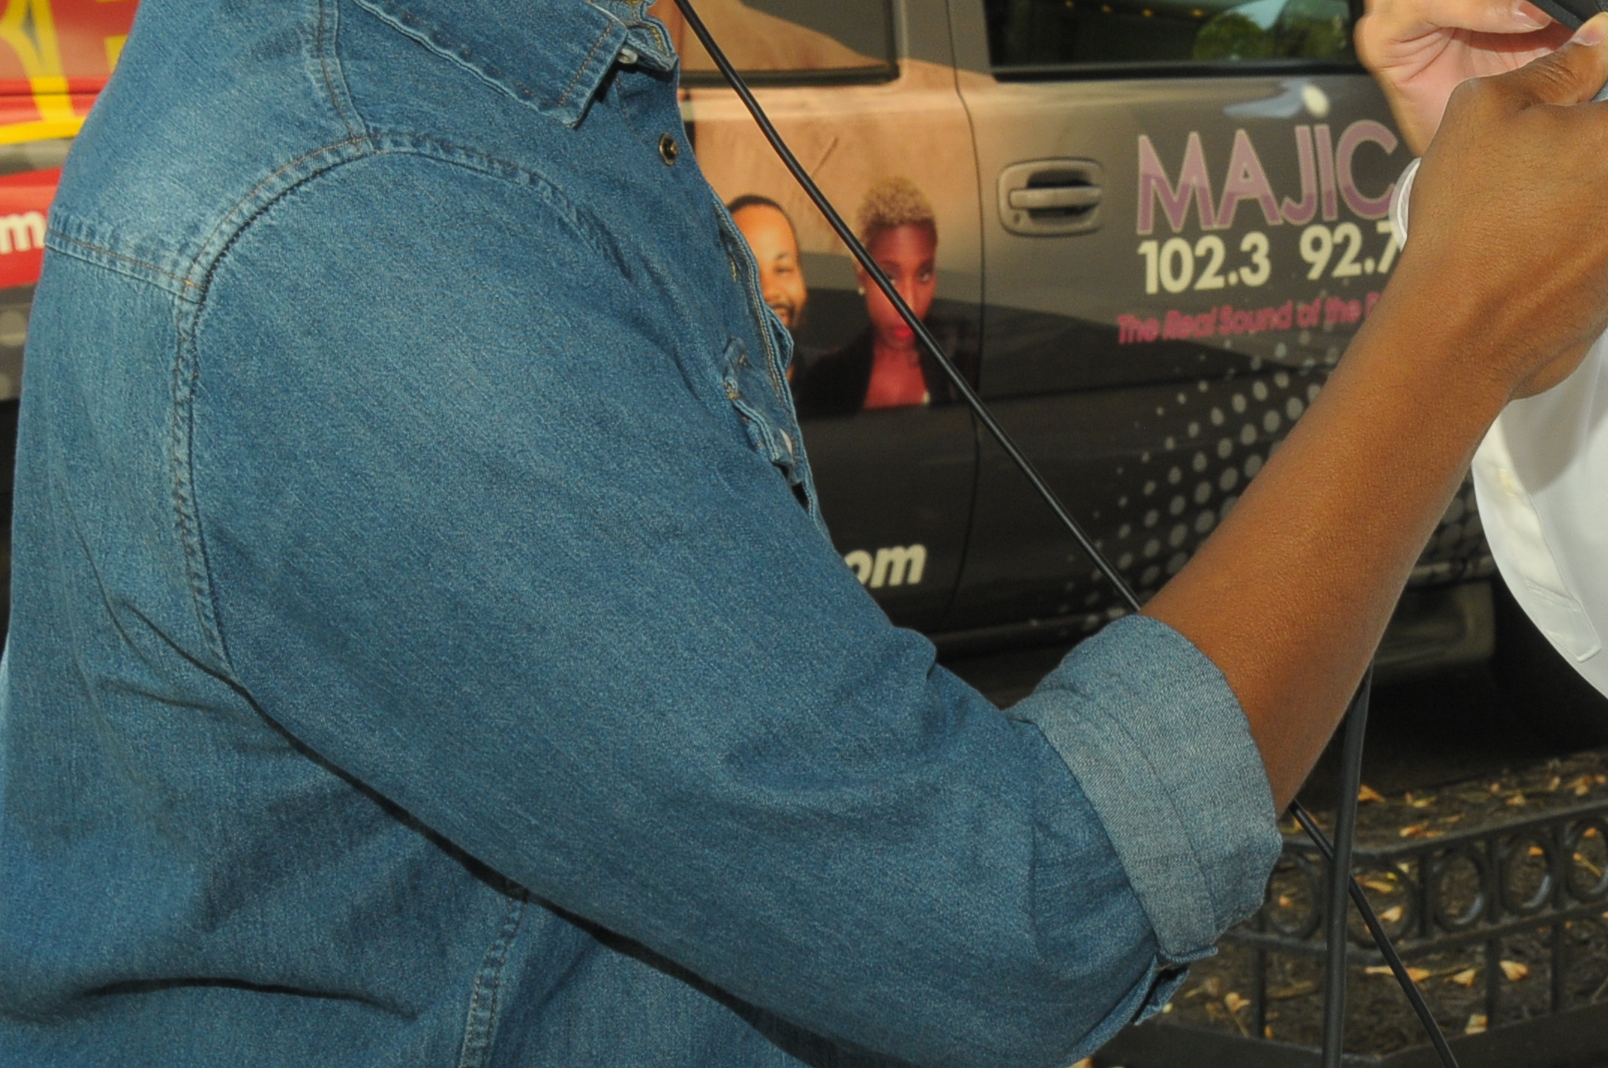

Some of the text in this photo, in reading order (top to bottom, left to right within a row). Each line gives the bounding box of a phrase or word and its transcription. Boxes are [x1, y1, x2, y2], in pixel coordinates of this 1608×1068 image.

[1136, 85, 1399, 235] MAJIC
[1137, 222, 1401, 294] 102.3 92.7
[1117, 313, 1160, 344] The
[1162, 306, 1218, 340] Real
[1218, 300, 1294, 335] Sound
[1296, 298, 1322, 328] of
[1325, 294, 1362, 324] the
